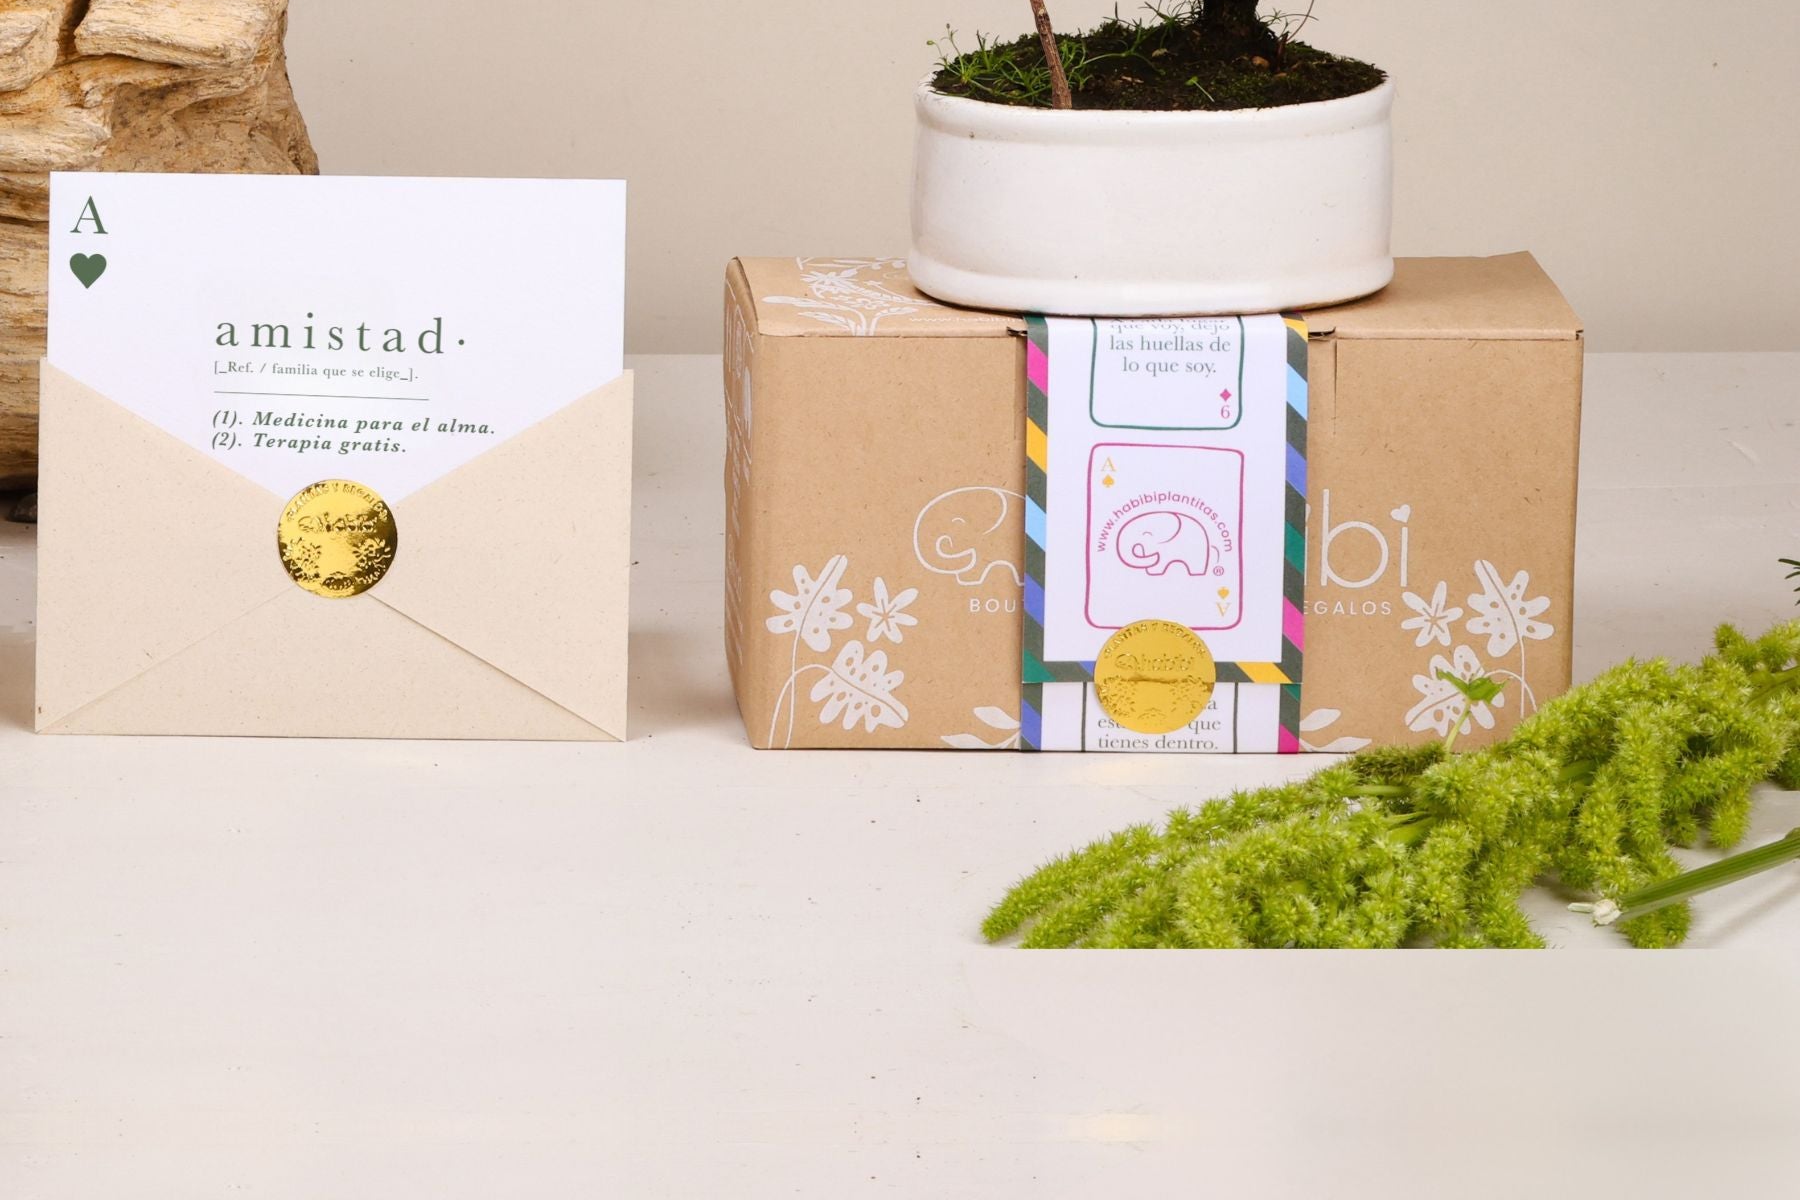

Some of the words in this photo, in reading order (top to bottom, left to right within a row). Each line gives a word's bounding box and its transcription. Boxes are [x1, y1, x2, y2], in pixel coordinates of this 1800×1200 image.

[69, 195, 109, 235] A
[1110, 334, 1134, 351] las
[1140, 334, 1204, 352] huellas
[1209, 336, 1231, 352] de
[272, 362, 318, 376] familia
[323, 367, 347, 380] que
[351, 369, 365, 378] se
[1122, 356, 1140, 373] lo
[1145, 360, 1179, 377] que
[1185, 361, 1216, 378] soy.
[212, 410, 243, 428] (1).
[252, 411, 348, 429] Medicina
[354, 419, 403, 434] para
[411, 417, 430, 432] el
[437, 418, 496, 435] alma.
[211, 432, 242, 450] (2).
[253, 433, 332, 454] Terapia
[339, 436, 406, 455] gratis.
[1101, 457, 1116, 472] A
[1097, 491, 1233, 552] www.habibiplantitas.com
[1189, 721, 1221, 734] que
[1099, 733, 1149, 749] tienes
[1155, 735, 1218, 750] dentro.
